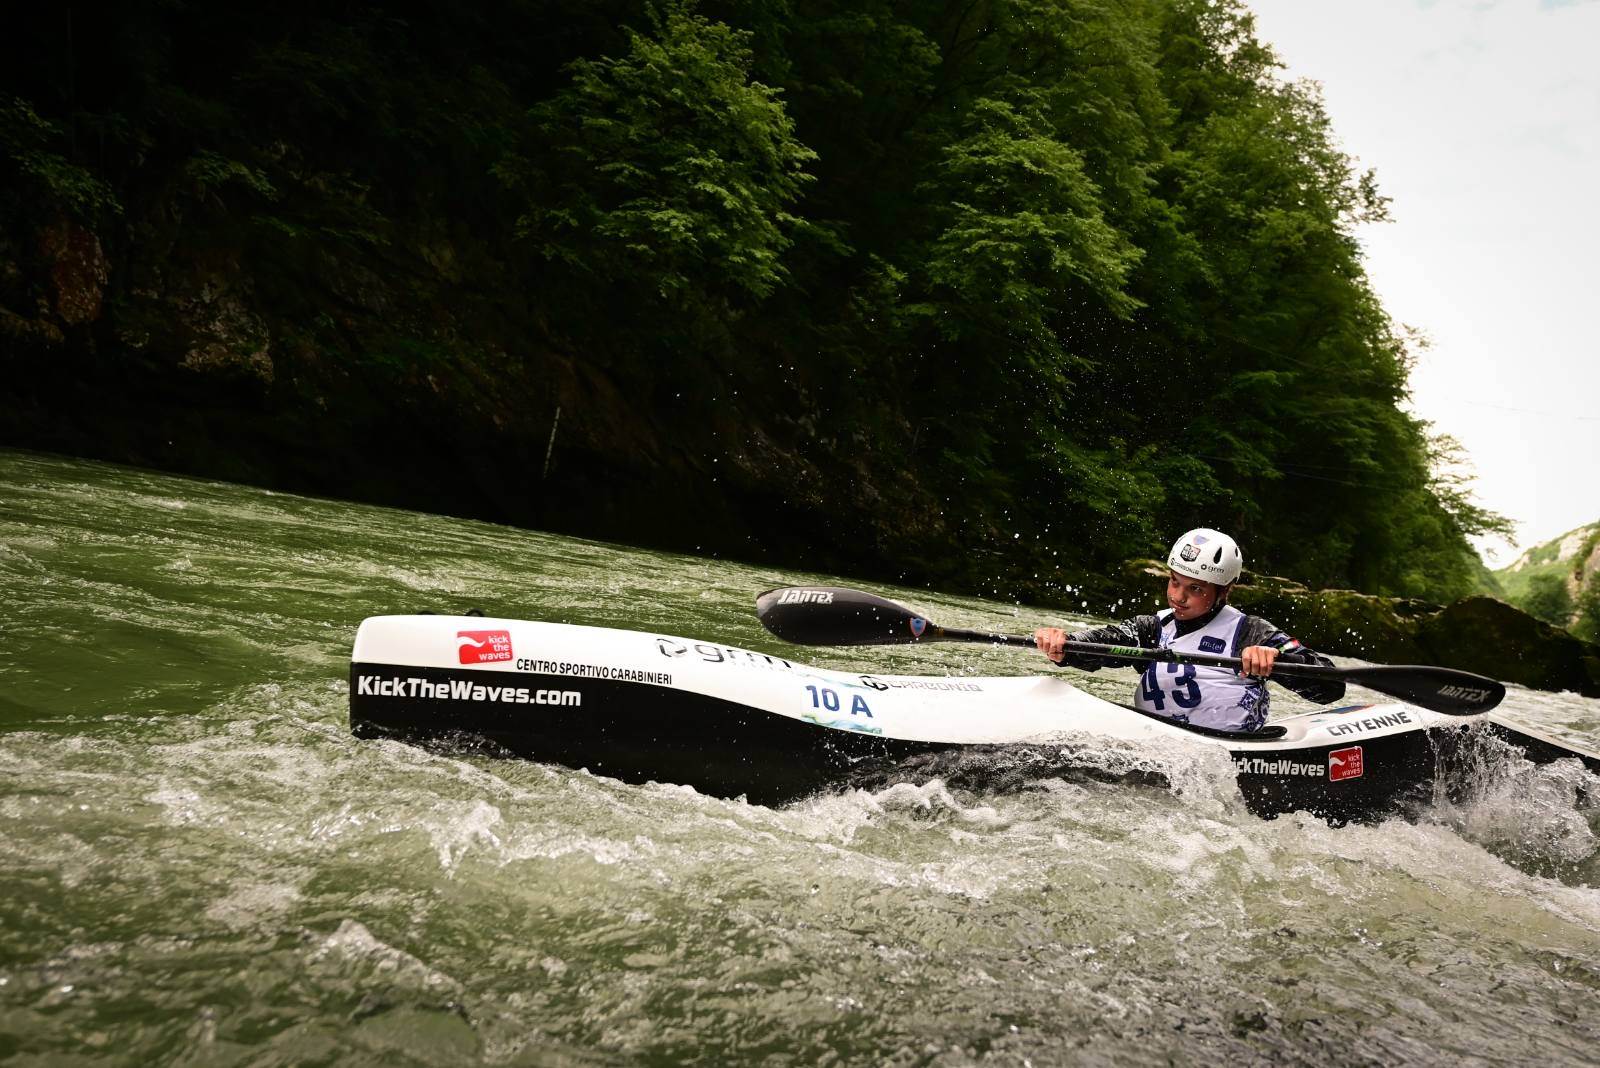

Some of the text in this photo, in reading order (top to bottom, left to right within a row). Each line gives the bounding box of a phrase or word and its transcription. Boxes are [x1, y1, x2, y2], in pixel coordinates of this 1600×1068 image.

[488, 636, 508, 644] kick
[479, 652, 510, 661] waves
[517, 659, 672, 685] CENTRO SPORTIVO CARABINIERI
[358, 676, 581, 707] KickTheWaves.com
[805, 685, 873, 718] 10 A
[1326, 711, 1412, 737] CAYENNE
[1232, 757, 1325, 777] ickTheWaves
[1341, 768, 1361, 777] waves
